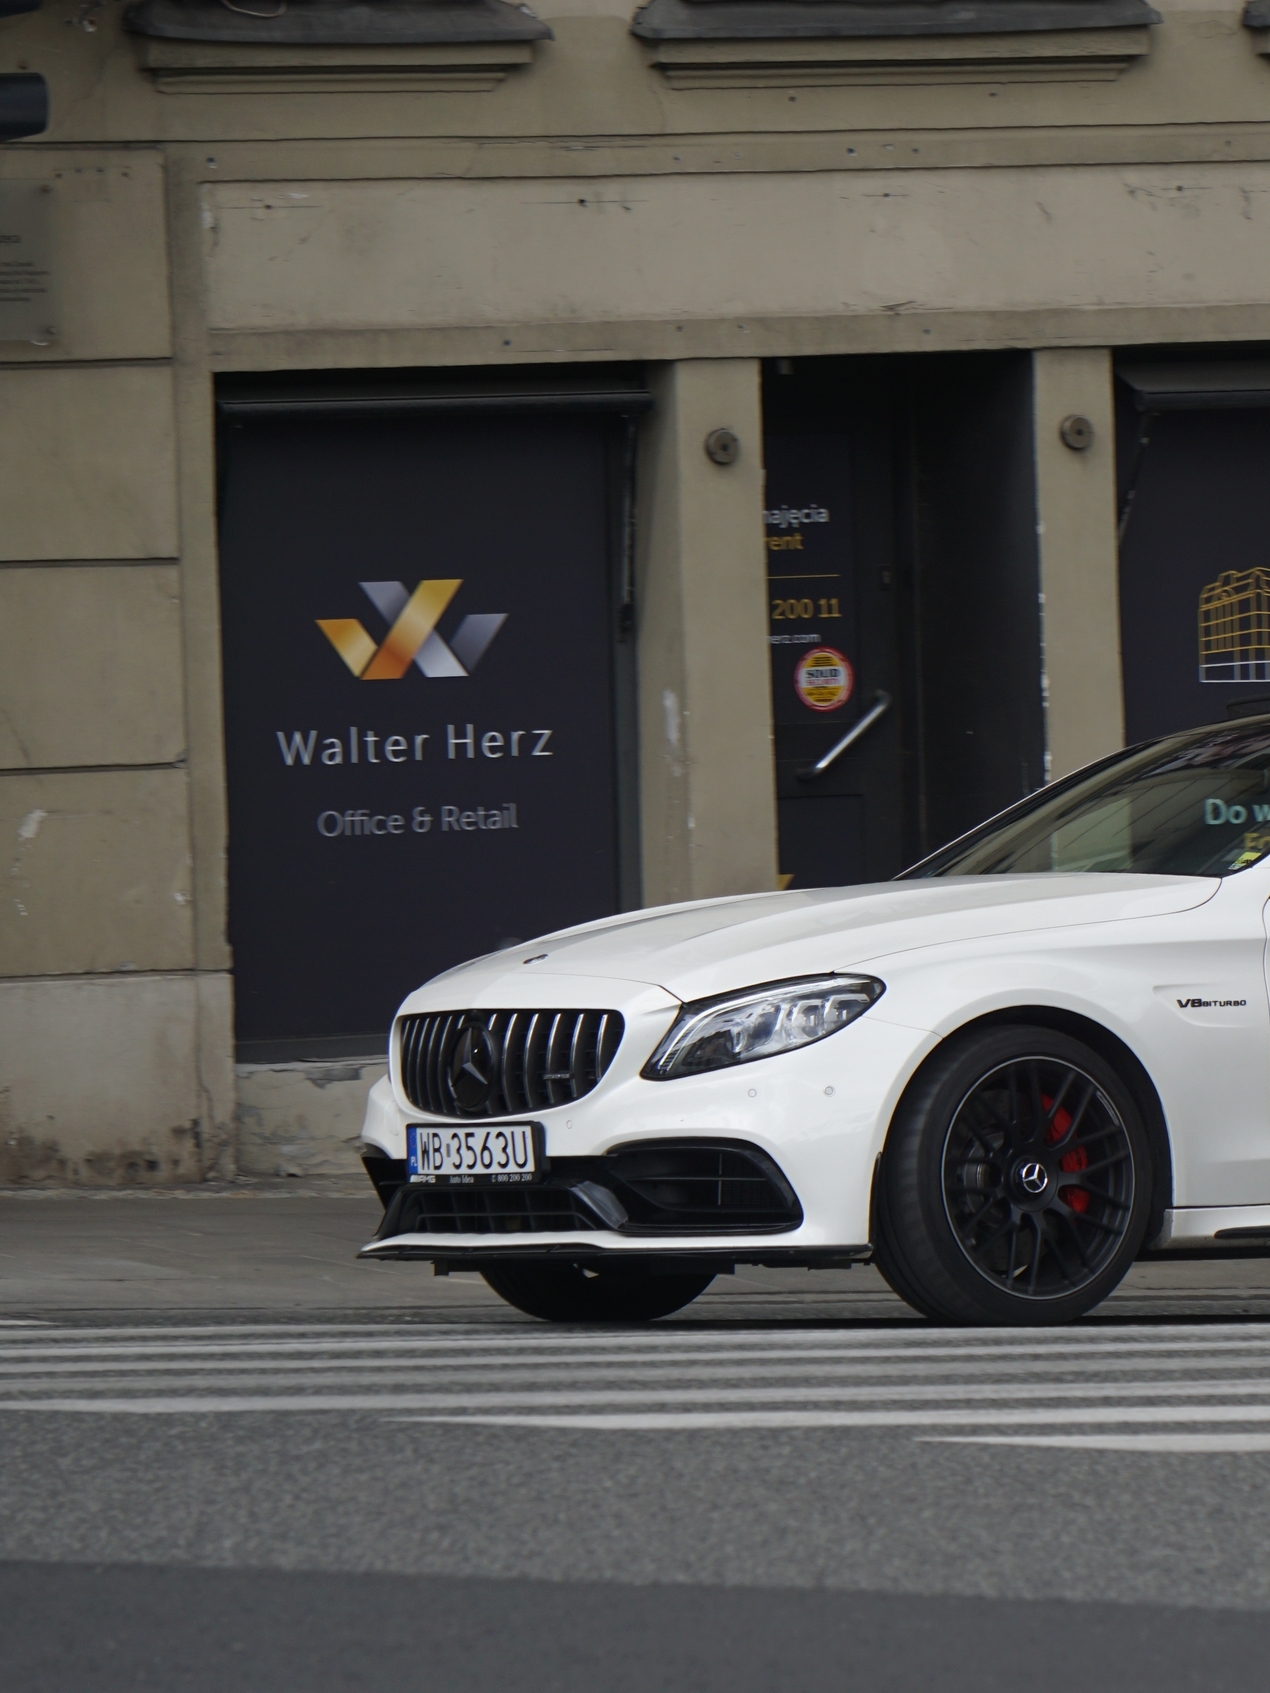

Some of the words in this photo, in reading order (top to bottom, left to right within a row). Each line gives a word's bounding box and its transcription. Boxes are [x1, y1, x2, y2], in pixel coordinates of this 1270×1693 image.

[771, 598, 814, 620] 200
[818, 596, 841, 619] 11
[277, 726, 430, 766] Walter
[447, 723, 554, 759] Herz
[317, 809, 405, 837] Office
[412, 806, 433, 834] &
[441, 803, 519, 831] Retail
[1204, 798, 1248, 825] Do
[420, 1132, 443, 1171] WB
[451, 1131, 528, 1170] 3563U
